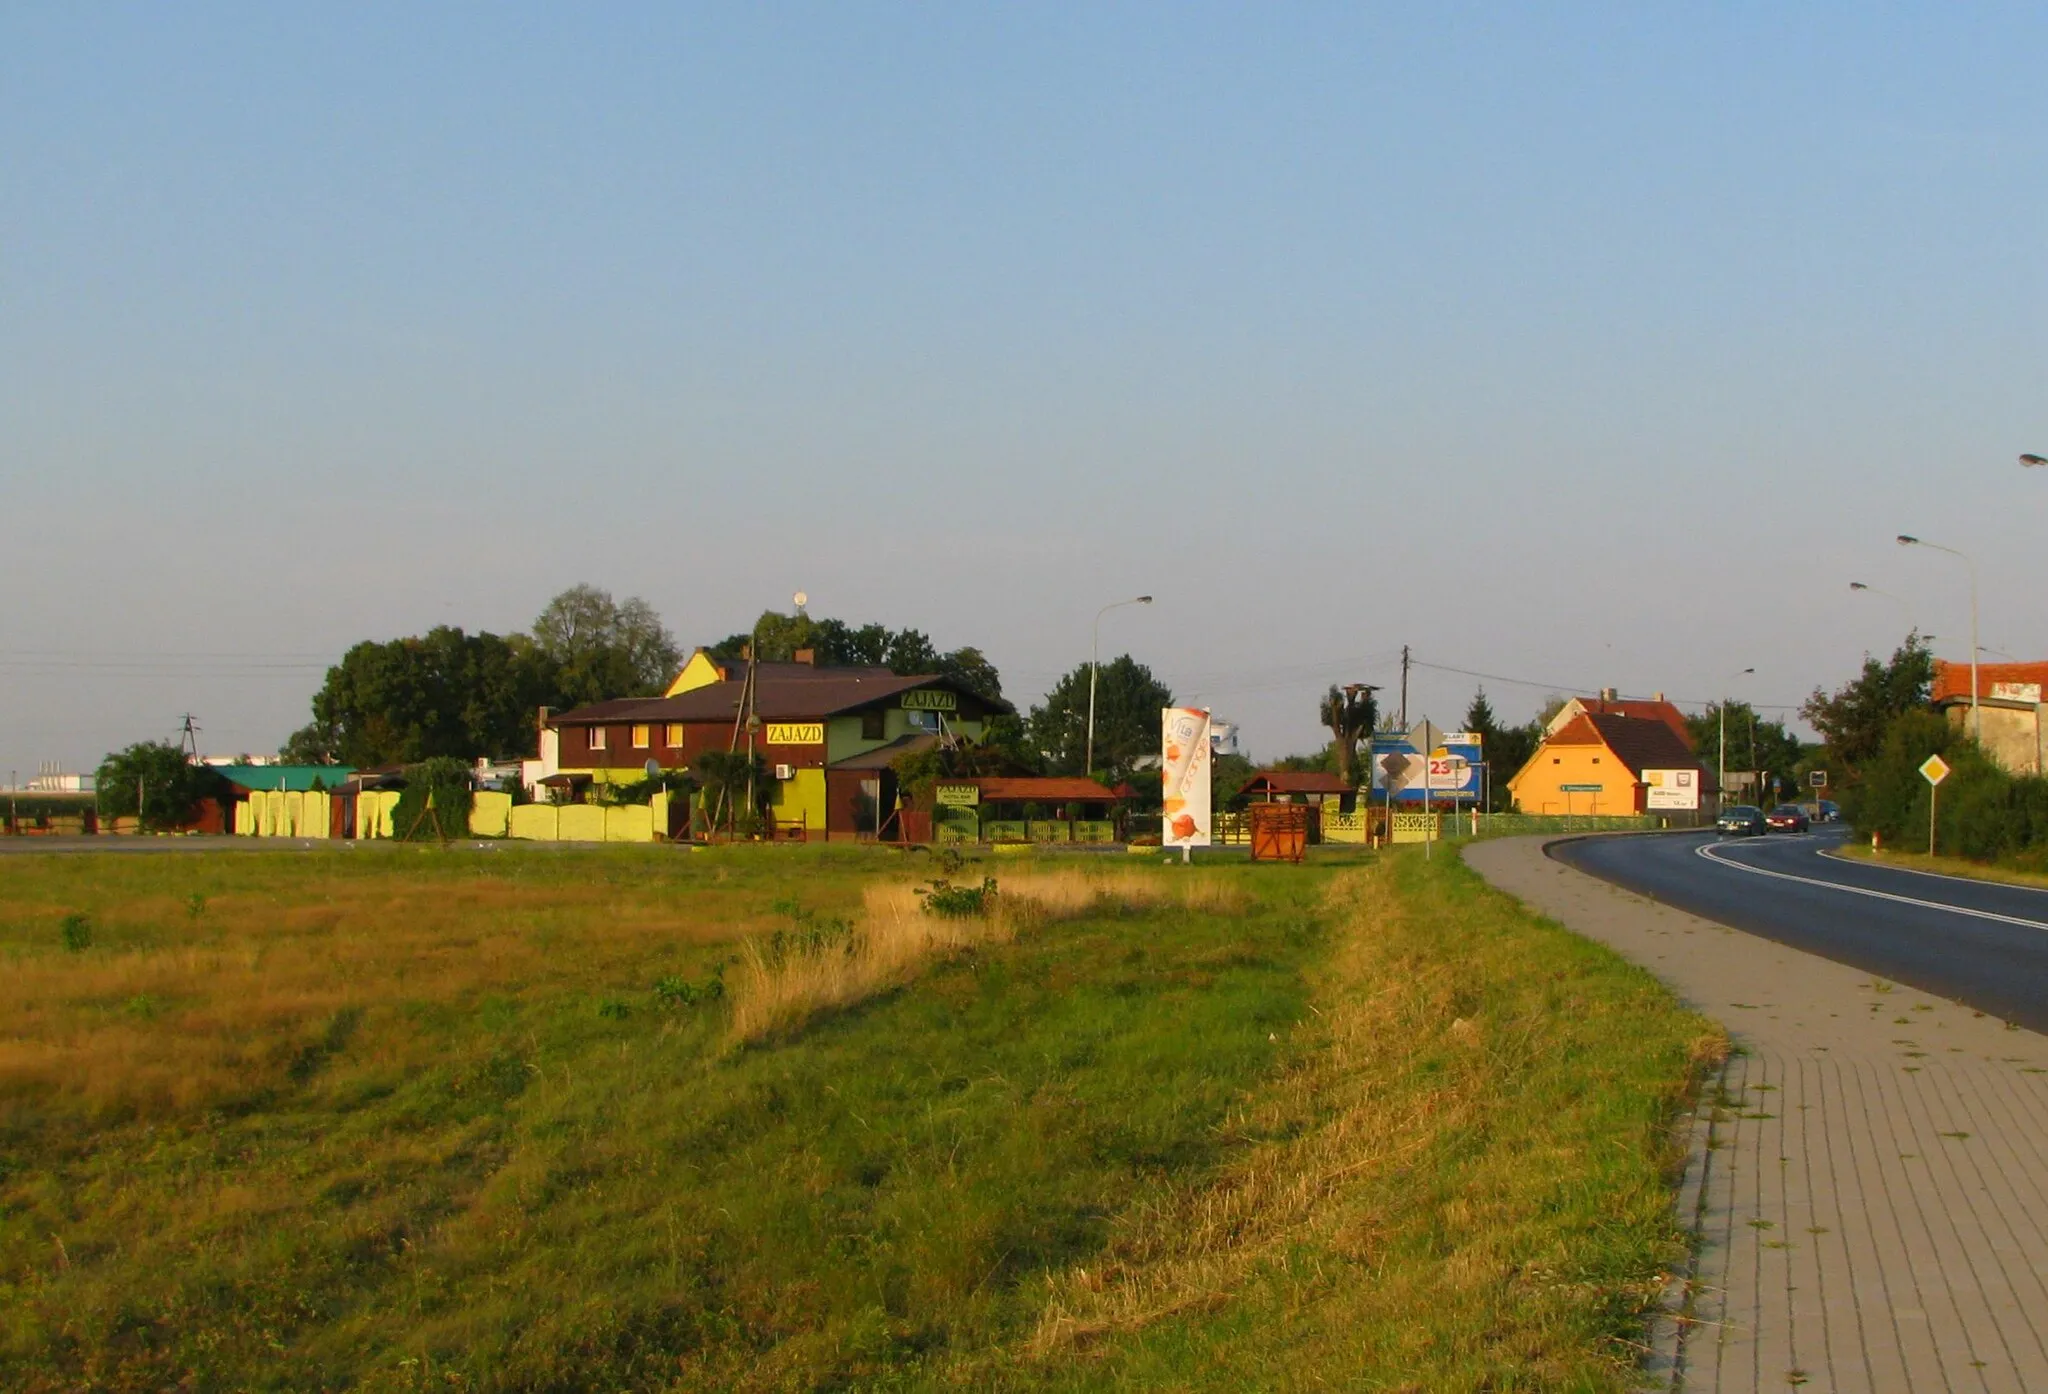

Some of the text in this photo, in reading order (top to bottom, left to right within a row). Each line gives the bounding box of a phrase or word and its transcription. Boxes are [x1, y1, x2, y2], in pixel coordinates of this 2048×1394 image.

[903, 692, 956, 708] ZAJAZD
[768, 725, 822, 742] ZAJAZD
[938, 784, 977, 794] ZAJAZD
